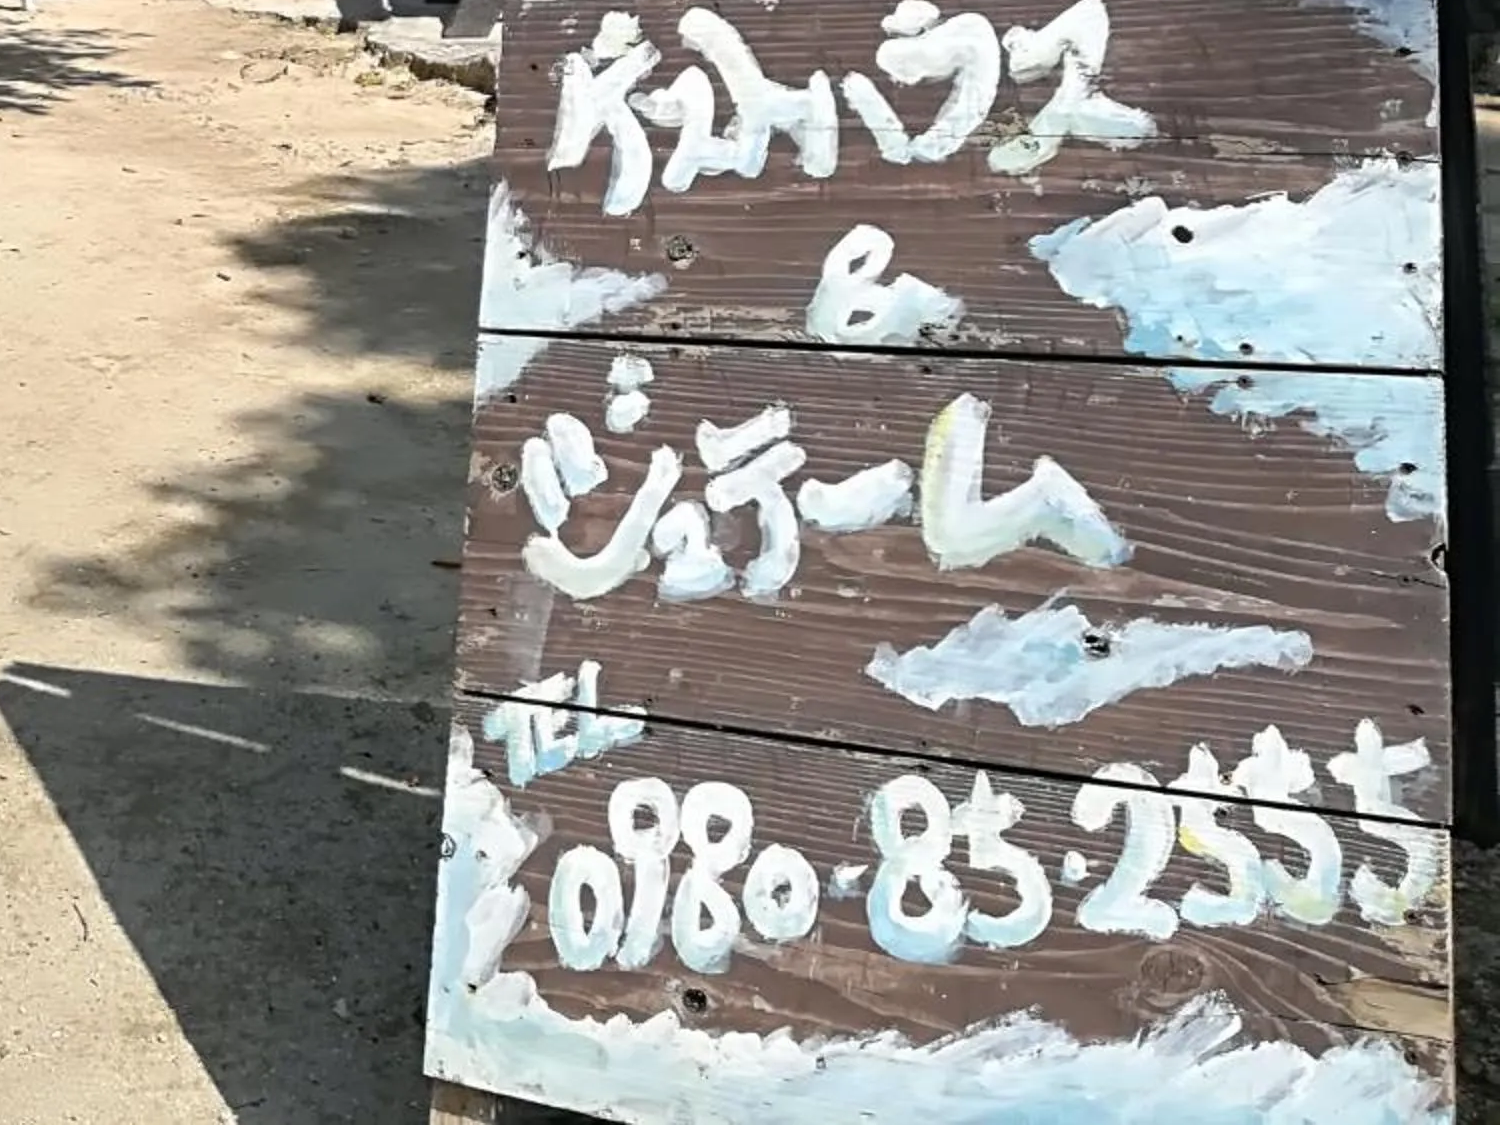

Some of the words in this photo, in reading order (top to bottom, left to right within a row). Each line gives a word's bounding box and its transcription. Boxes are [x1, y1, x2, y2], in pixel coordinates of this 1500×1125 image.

[520, 354, 1136, 601] ジュテーム
[483, 659, 649, 791] TEL
